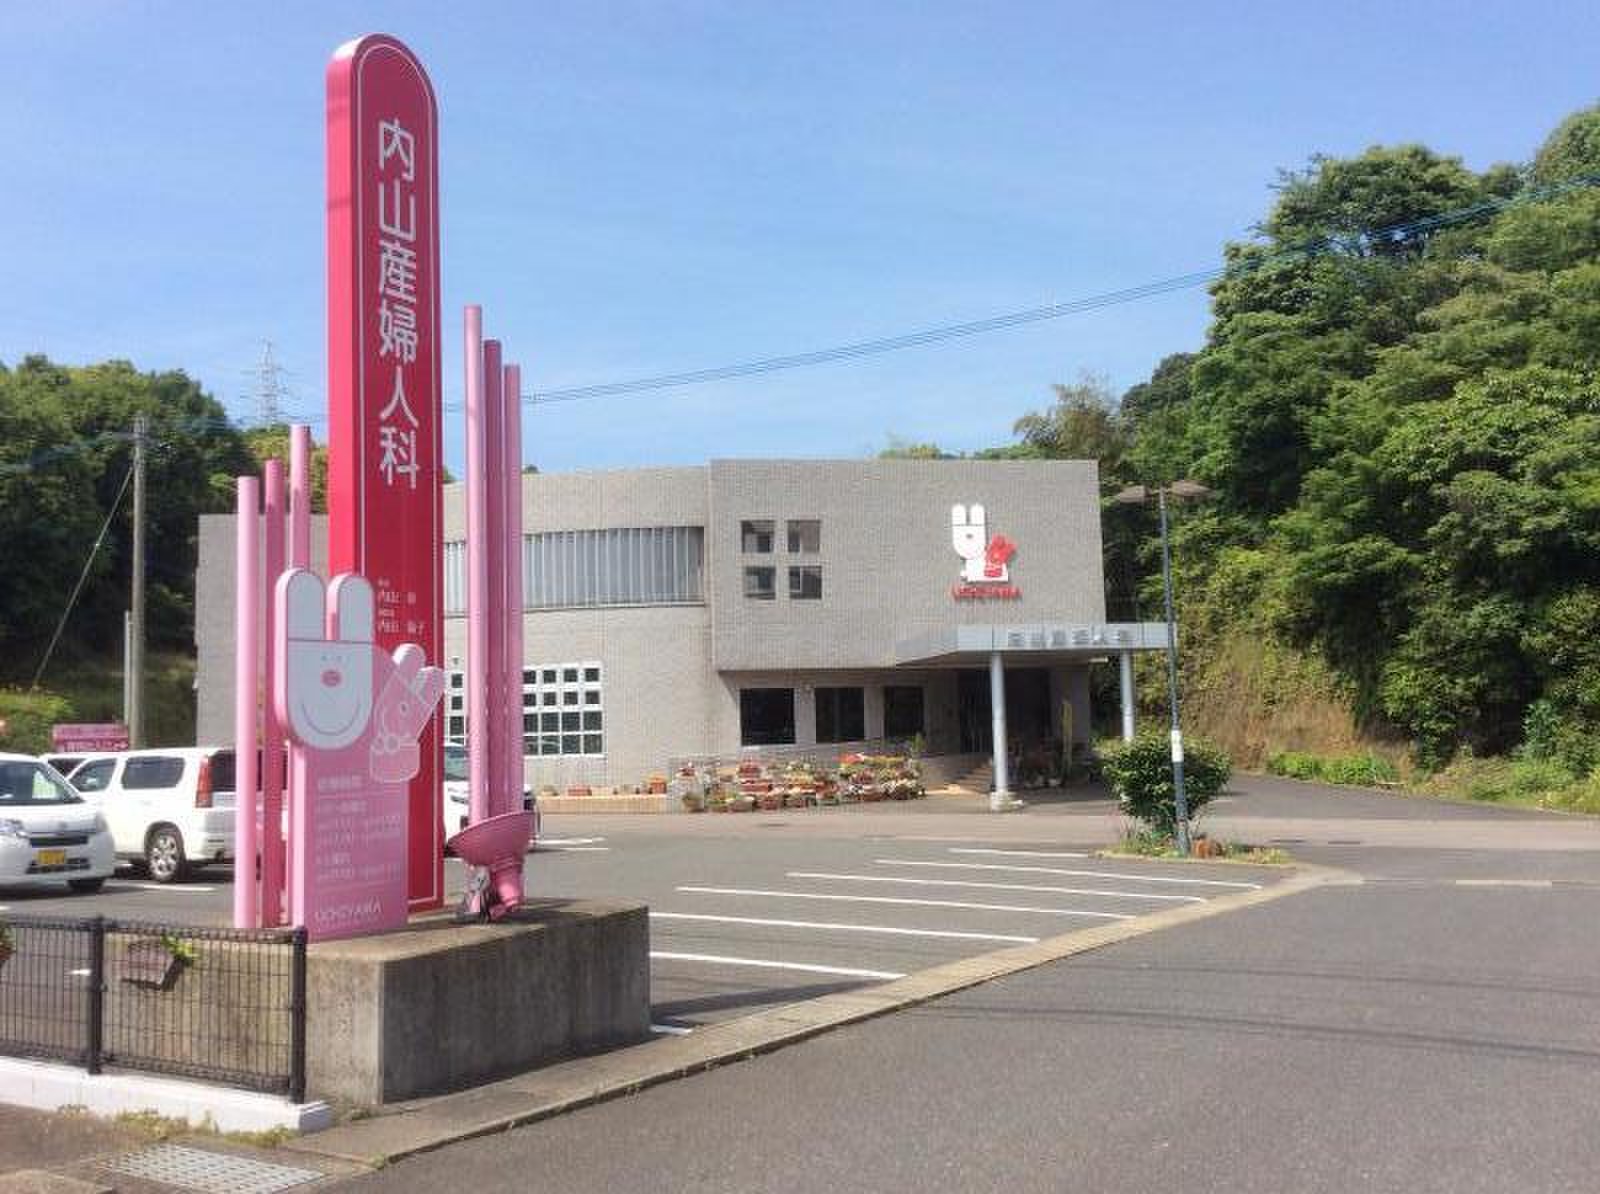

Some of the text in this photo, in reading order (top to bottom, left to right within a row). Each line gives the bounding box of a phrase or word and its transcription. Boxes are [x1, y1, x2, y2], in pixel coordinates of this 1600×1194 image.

[377, 116, 420, 490] 内山産婦人科
